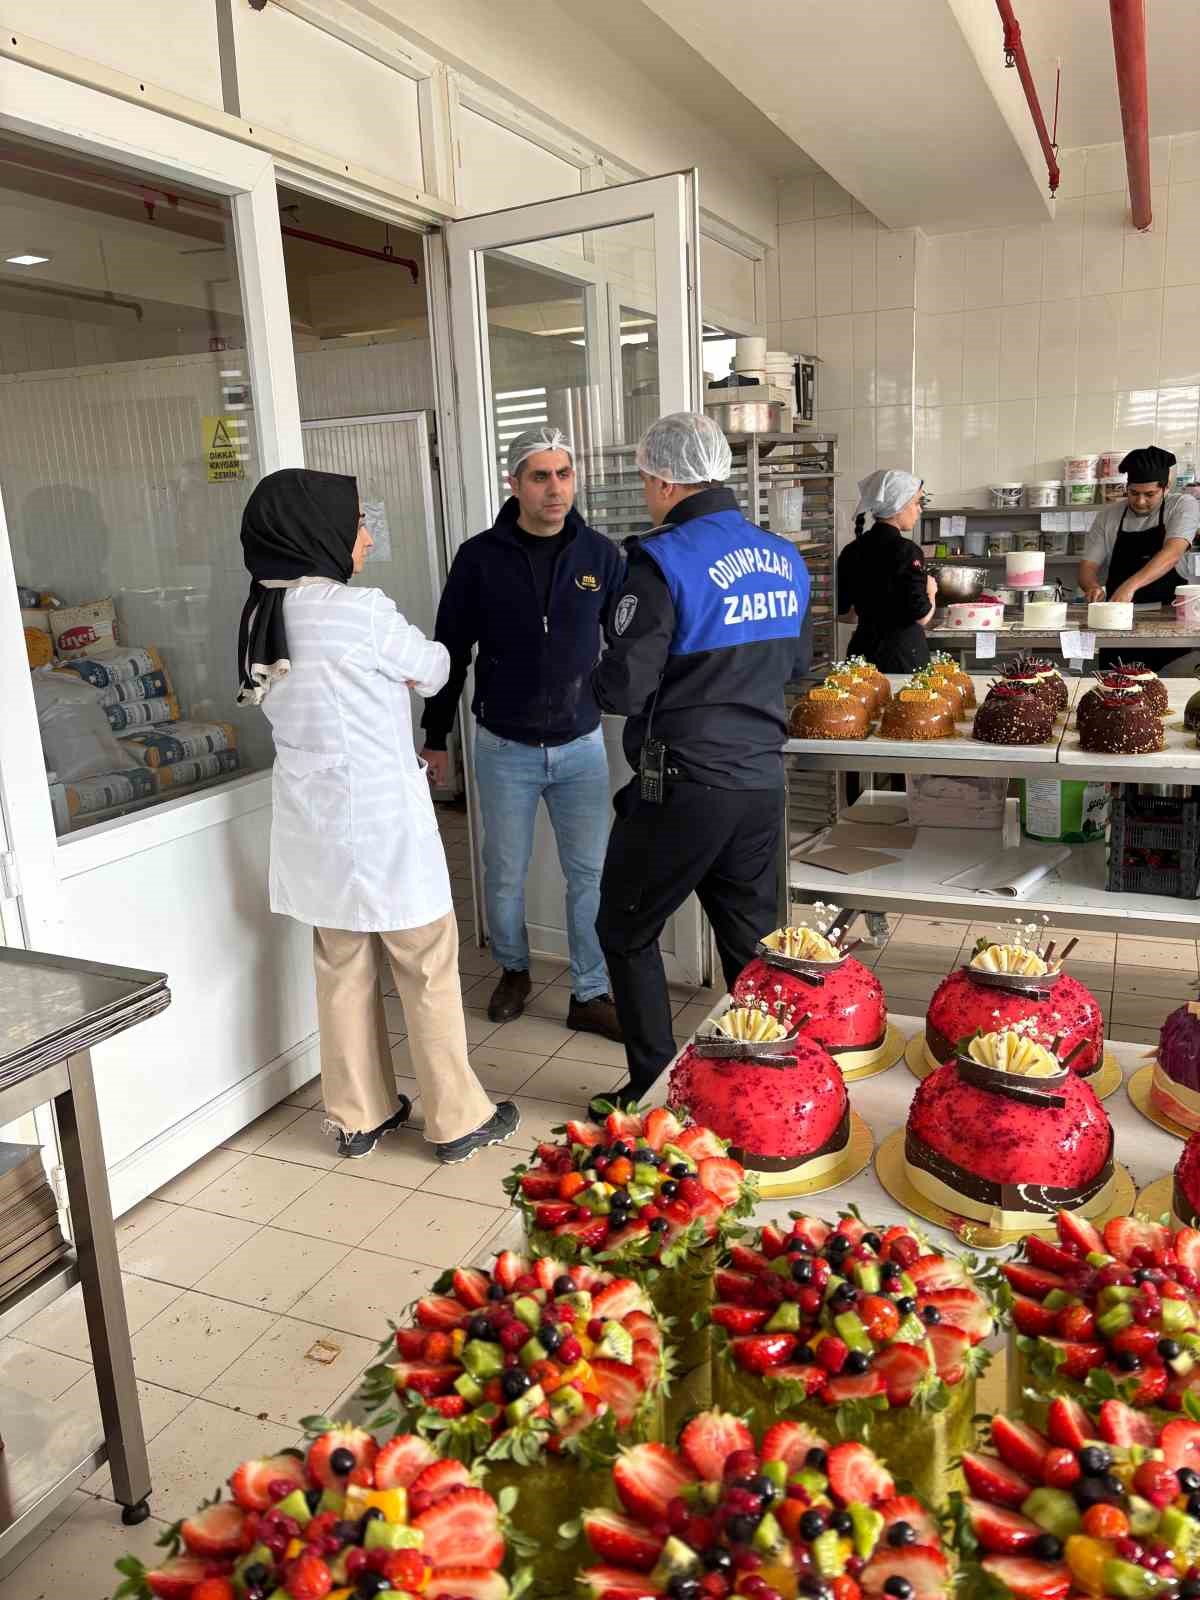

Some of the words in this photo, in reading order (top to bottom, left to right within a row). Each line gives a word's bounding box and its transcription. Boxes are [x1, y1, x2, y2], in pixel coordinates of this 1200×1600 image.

[209, 450, 236, 460] DİKKAT
[708, 547, 793, 590] ODUNPAZARI
[723, 590, 798, 625] ZABITA
